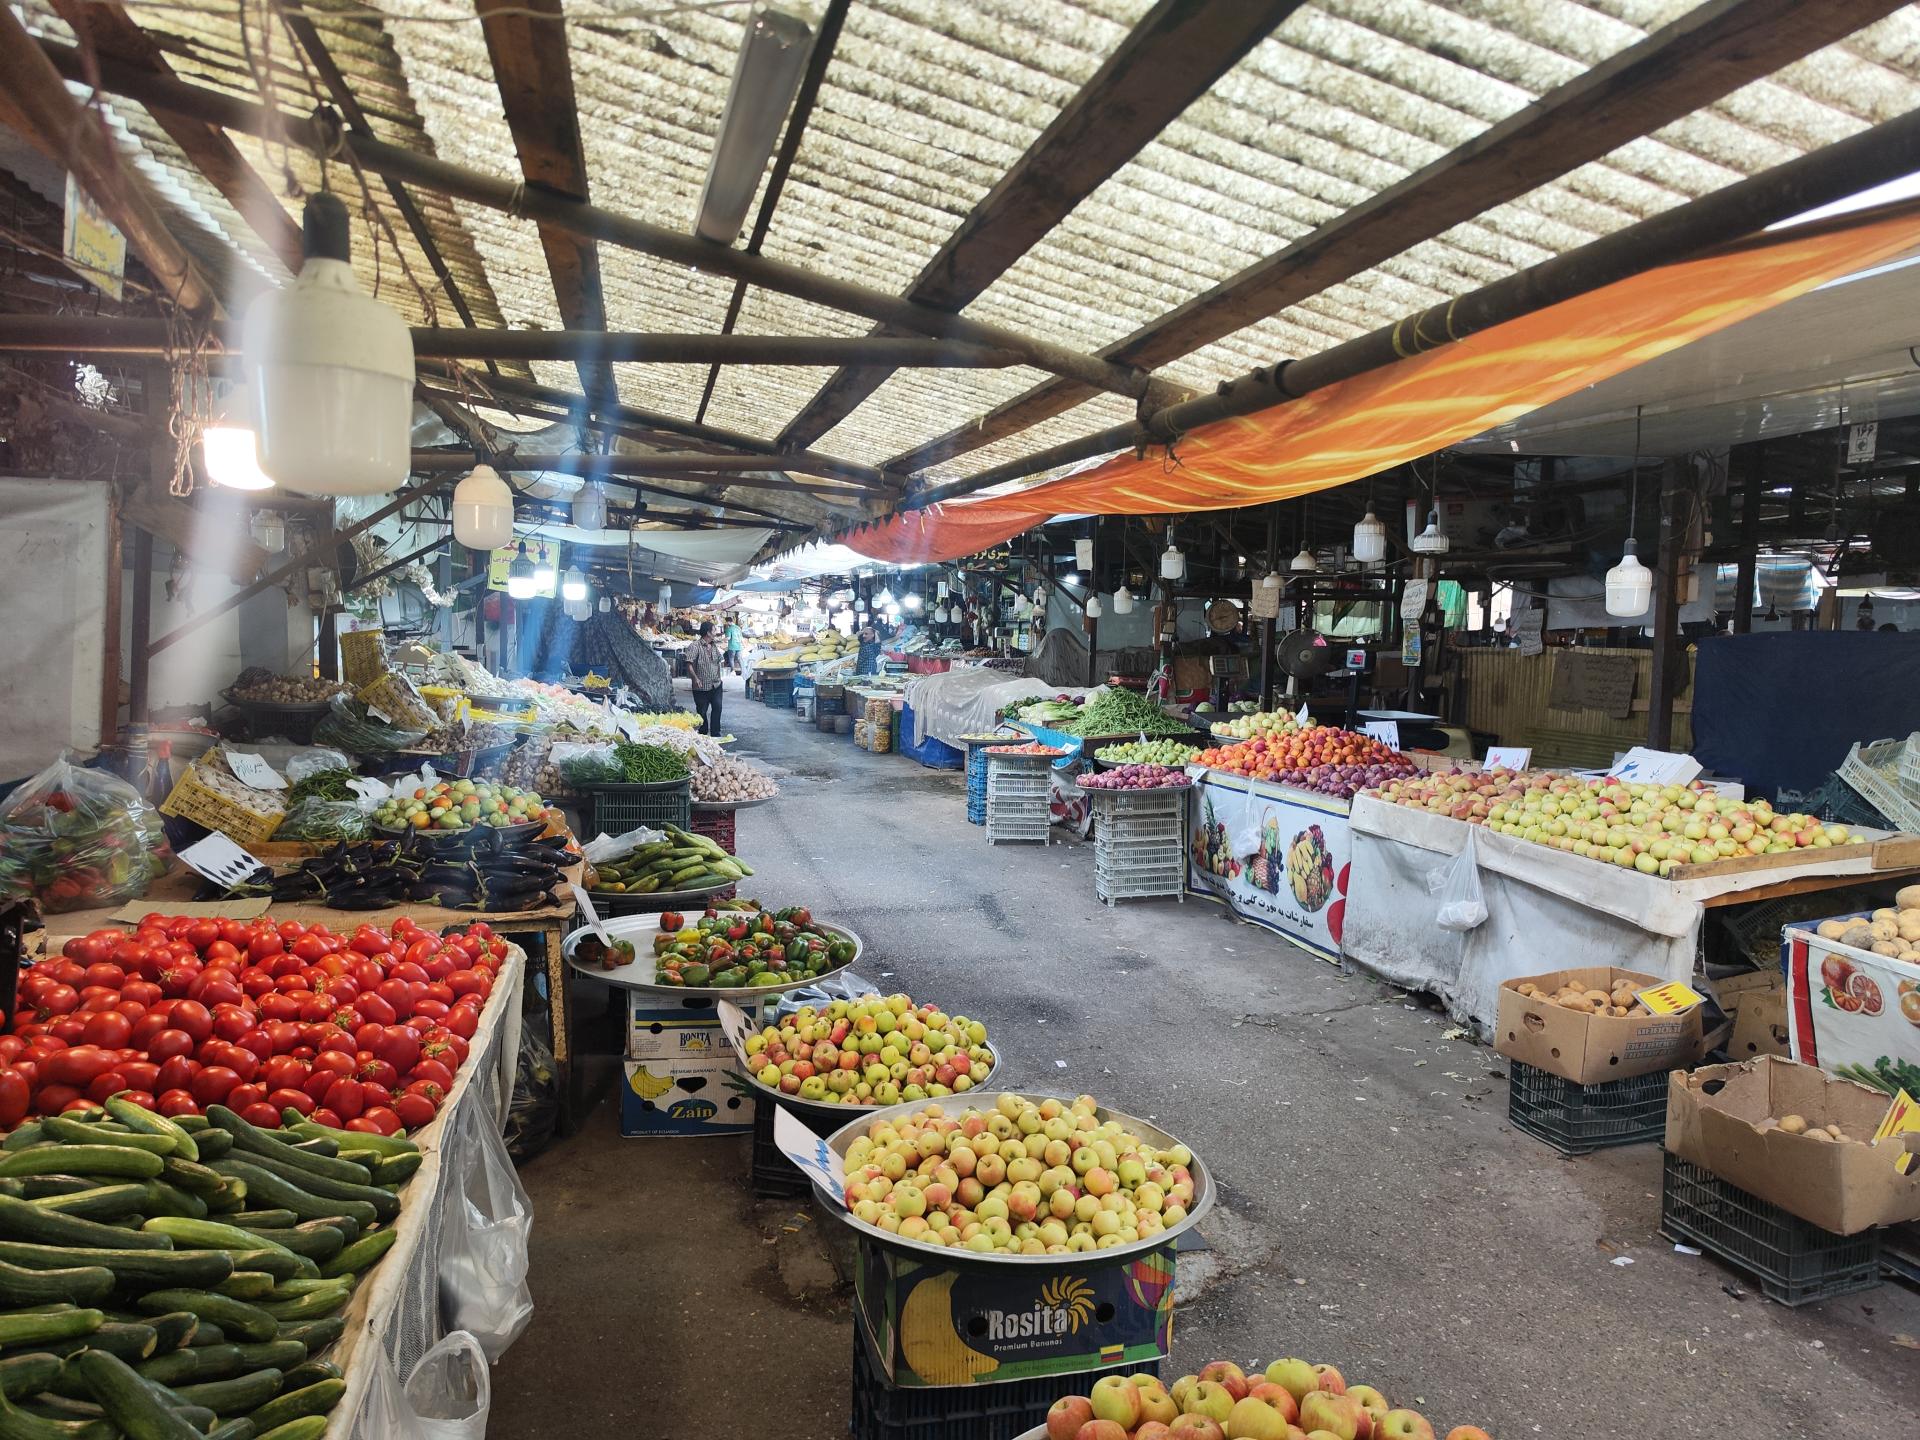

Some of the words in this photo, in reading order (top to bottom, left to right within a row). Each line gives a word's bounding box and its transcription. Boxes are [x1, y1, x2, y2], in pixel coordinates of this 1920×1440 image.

[680, 1032, 711, 1047] BONITA
[671, 1106, 713, 1119] Zain
[988, 1303, 1068, 1340] Rosita
[994, 1342, 1028, 1352] Premium
[1030, 1339, 1063, 1348] Bananas
